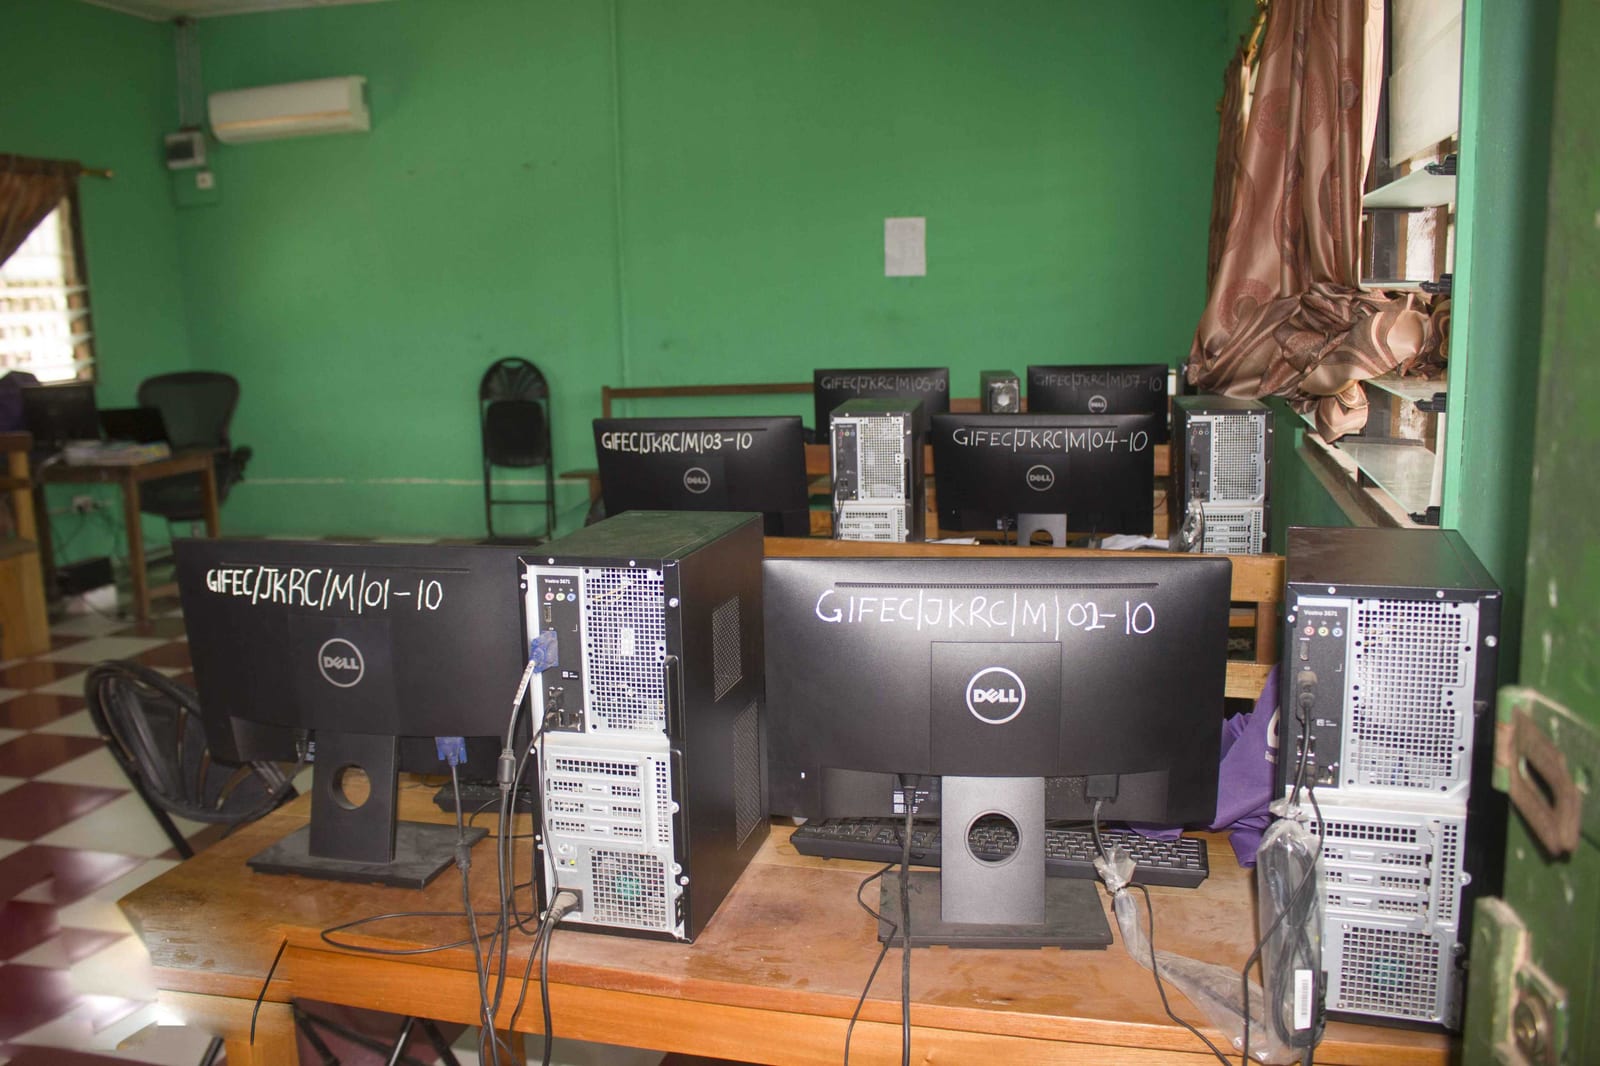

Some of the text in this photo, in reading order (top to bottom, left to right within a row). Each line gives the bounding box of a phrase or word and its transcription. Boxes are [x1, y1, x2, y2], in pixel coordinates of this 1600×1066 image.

[1029, 474, 1052, 482] DELL
[323, 655, 360, 670] DELL
[973, 688, 1019, 704] DELL
